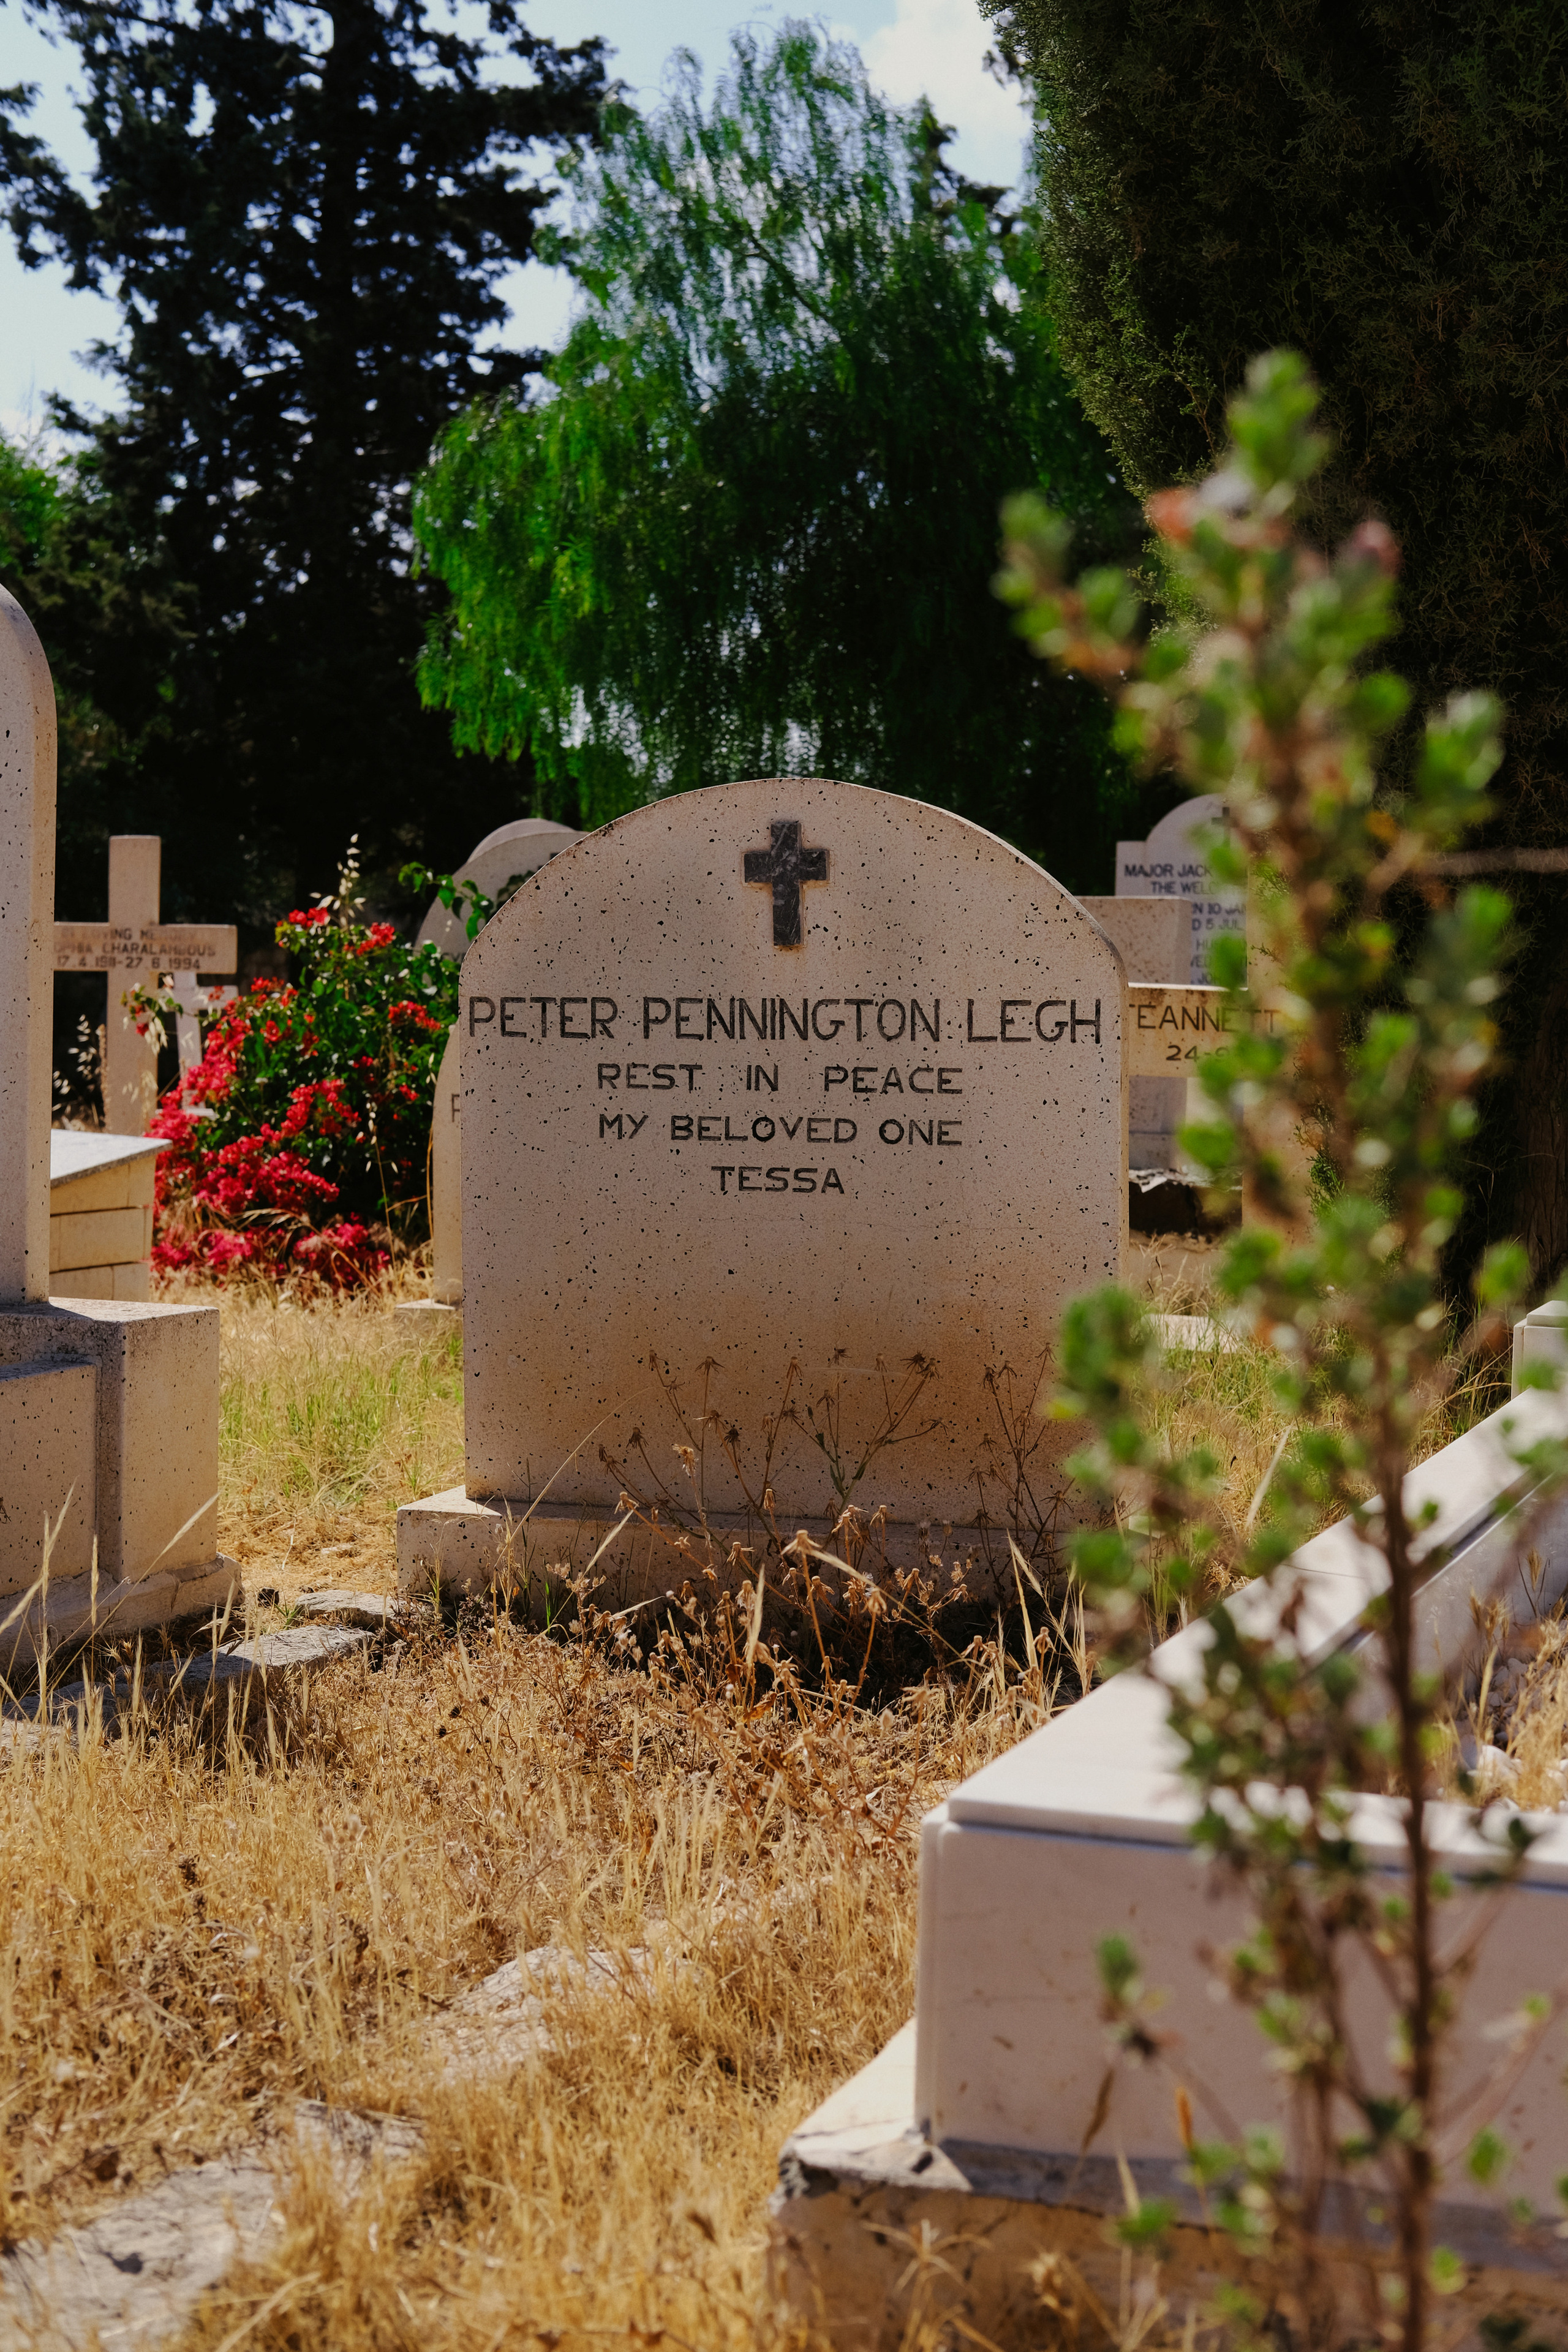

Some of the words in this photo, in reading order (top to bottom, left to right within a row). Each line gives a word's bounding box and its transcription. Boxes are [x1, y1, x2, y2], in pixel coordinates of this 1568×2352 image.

[1125, 863, 1174, 878] MAJOR
[1150, 881, 1177, 894] THE
[469, 996, 618, 1039] PETER
[643, 997, 940, 1042] PENNINGTON
[967, 998, 1101, 1044] LEGH
[597, 1062, 703, 1091] REST
[745, 1063, 779, 1092] IN
[824, 1064, 963, 1095] PEACE
[598, 1114, 649, 1140] MY
[670, 1114, 858, 1144] BELOVED
[878, 1118, 962, 1146] ONE
[710, 1166, 845, 1194] TESSA
